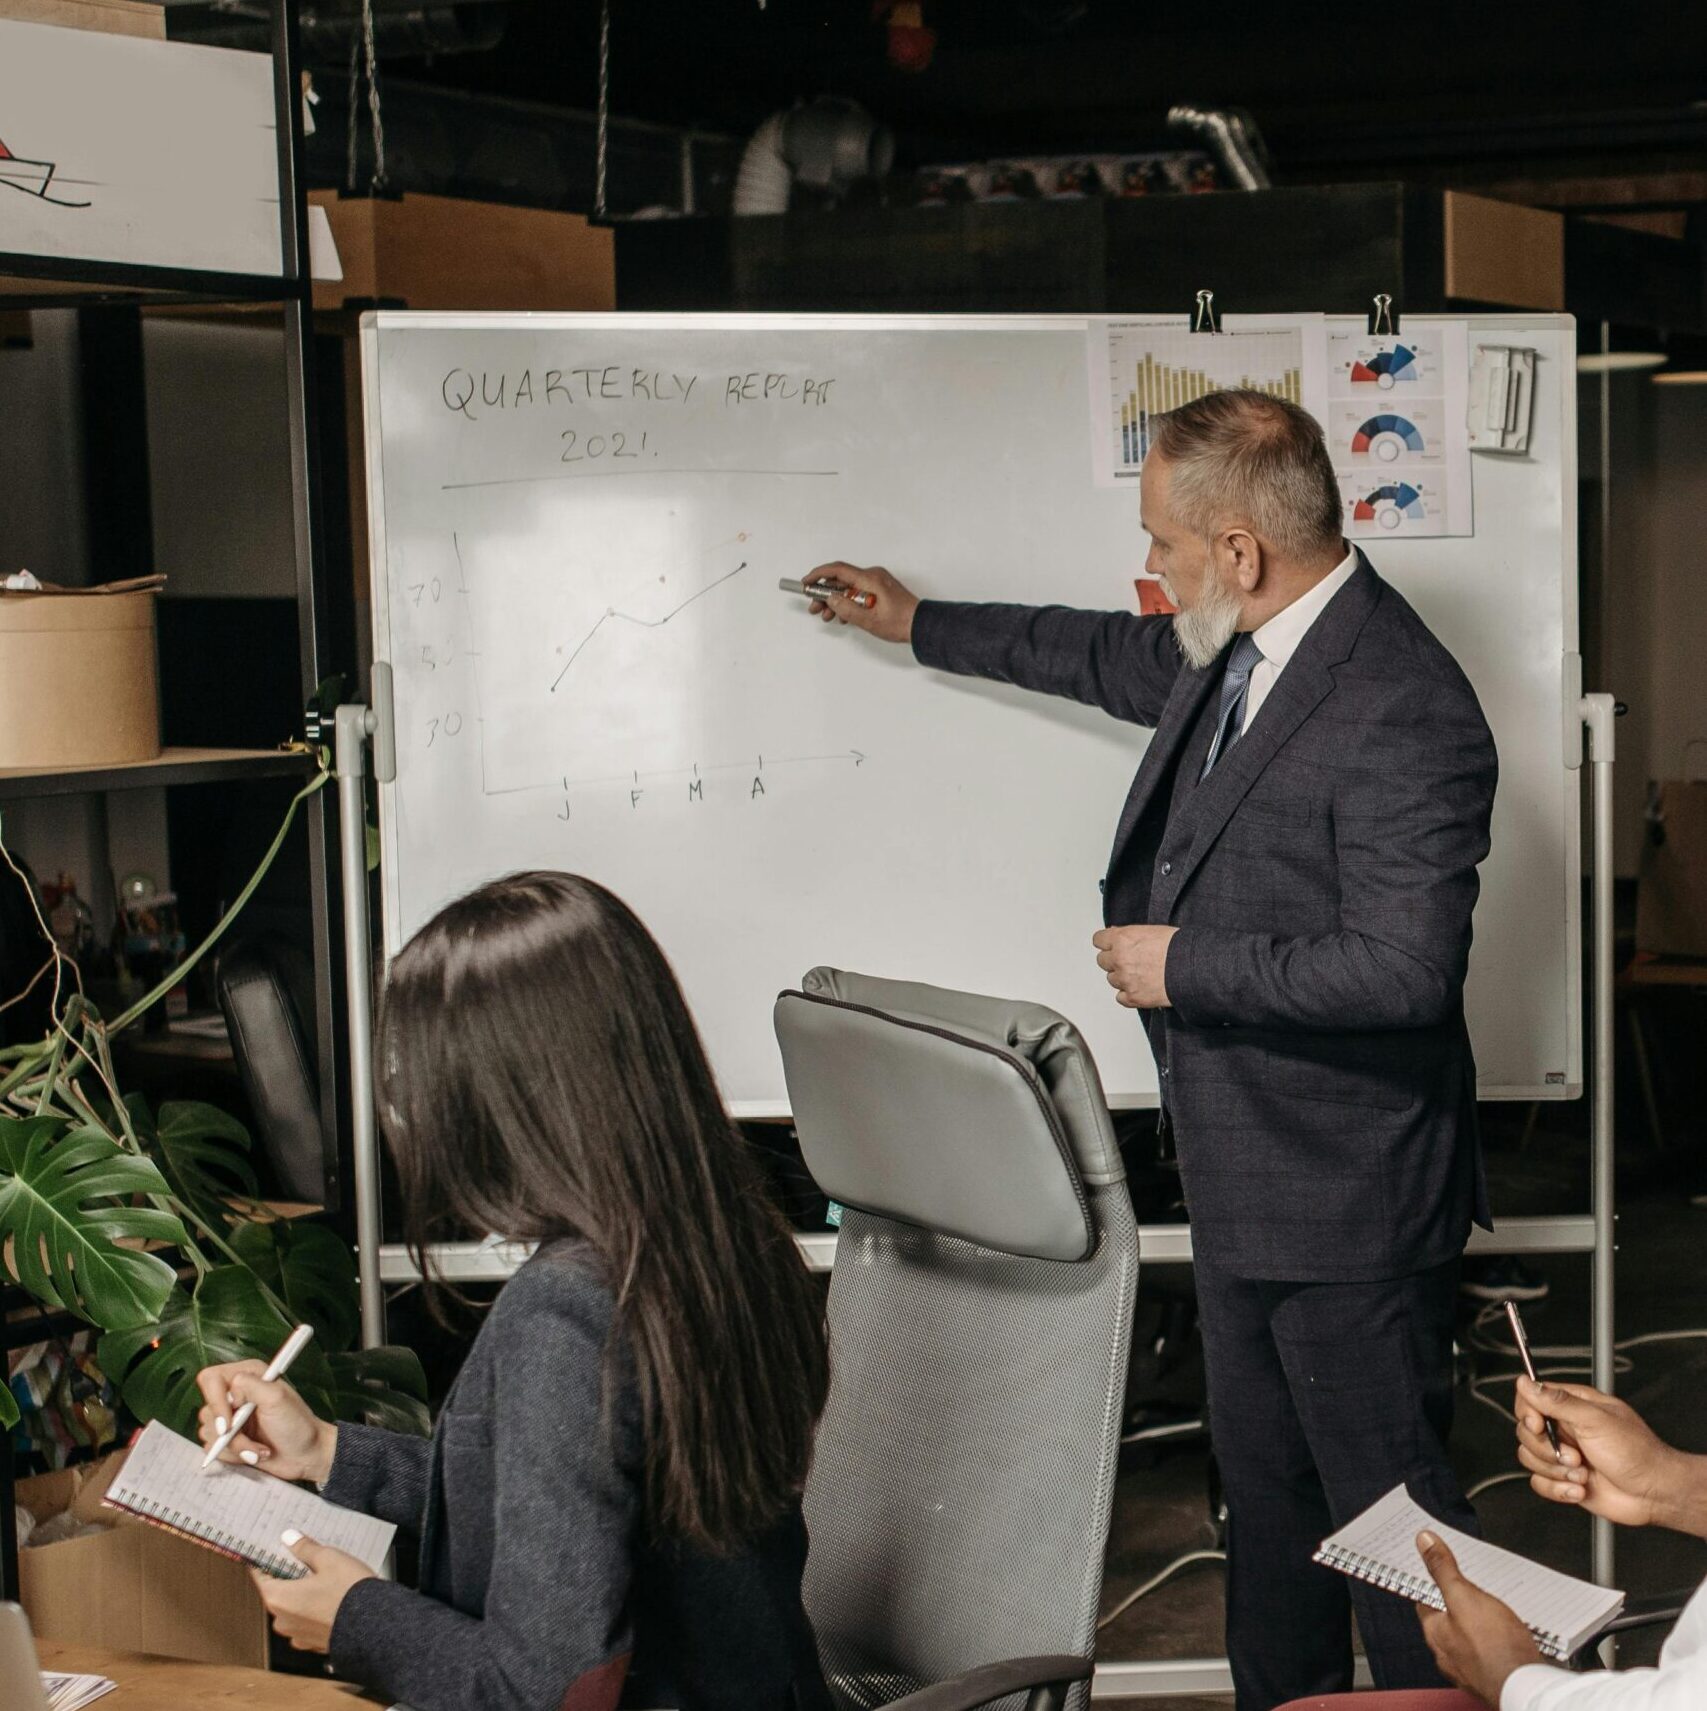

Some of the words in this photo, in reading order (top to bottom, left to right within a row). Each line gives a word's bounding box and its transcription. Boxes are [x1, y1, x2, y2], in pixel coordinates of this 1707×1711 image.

[442, 366, 698, 420] QUARTERLY
[725, 372, 837, 407] REPORT
[408, 576, 442, 608] 70
[425, 711, 463, 748] 30
[556, 799, 571, 822] J
[630, 789, 645, 810] F
[688, 778, 704, 802] M
[751, 776, 766, 800] A
